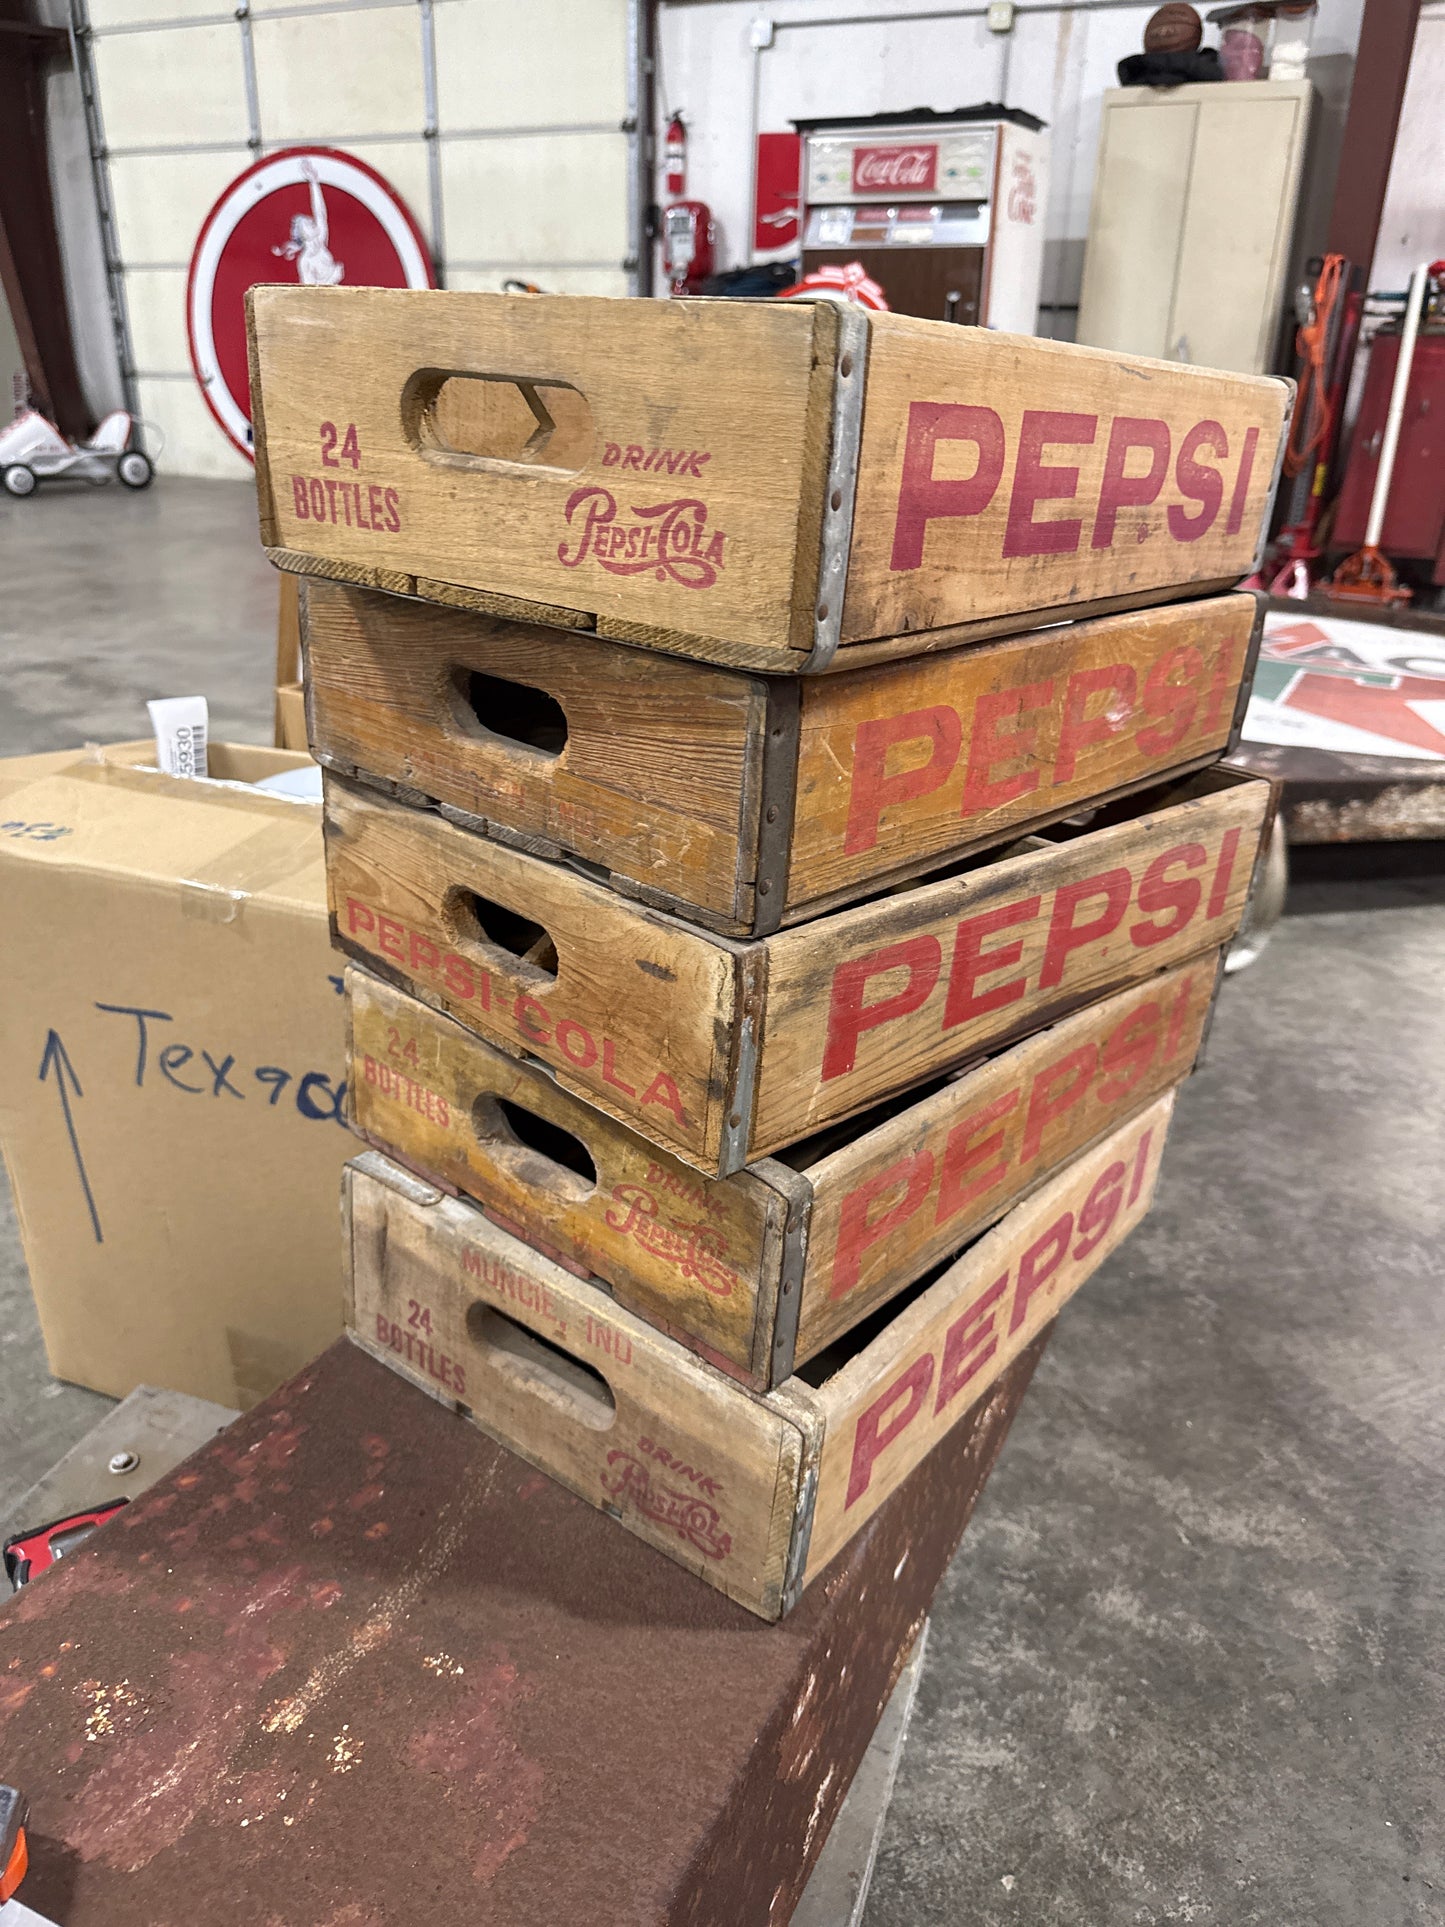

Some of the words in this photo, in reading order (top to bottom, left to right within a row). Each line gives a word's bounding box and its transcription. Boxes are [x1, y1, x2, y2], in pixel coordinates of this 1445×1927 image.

[320, 421, 361, 470] 24
[602, 442, 711, 478] DRINK
[292, 476, 400, 532] BOTTLES
[890, 401, 1260, 571] PEPSI
[844, 636, 1235, 856] PEPSI
[822, 829, 1241, 1082] PEPSI
[347, 897, 687, 1128] PEPSI-COLA
[388, 1026, 420, 1066] 24
[364, 1053, 450, 1128] BOTTLES
[832, 976, 1194, 1299] PEPSI
[646, 1163, 730, 1222] DRINK
[408, 1299, 433, 1336] 24
[586, 1315, 633, 1365] IND
[845, 1129, 1152, 1510] PEPSI
[376, 1312, 466, 1394] BOTTLES
[637, 1436, 724, 1498] DRINK
